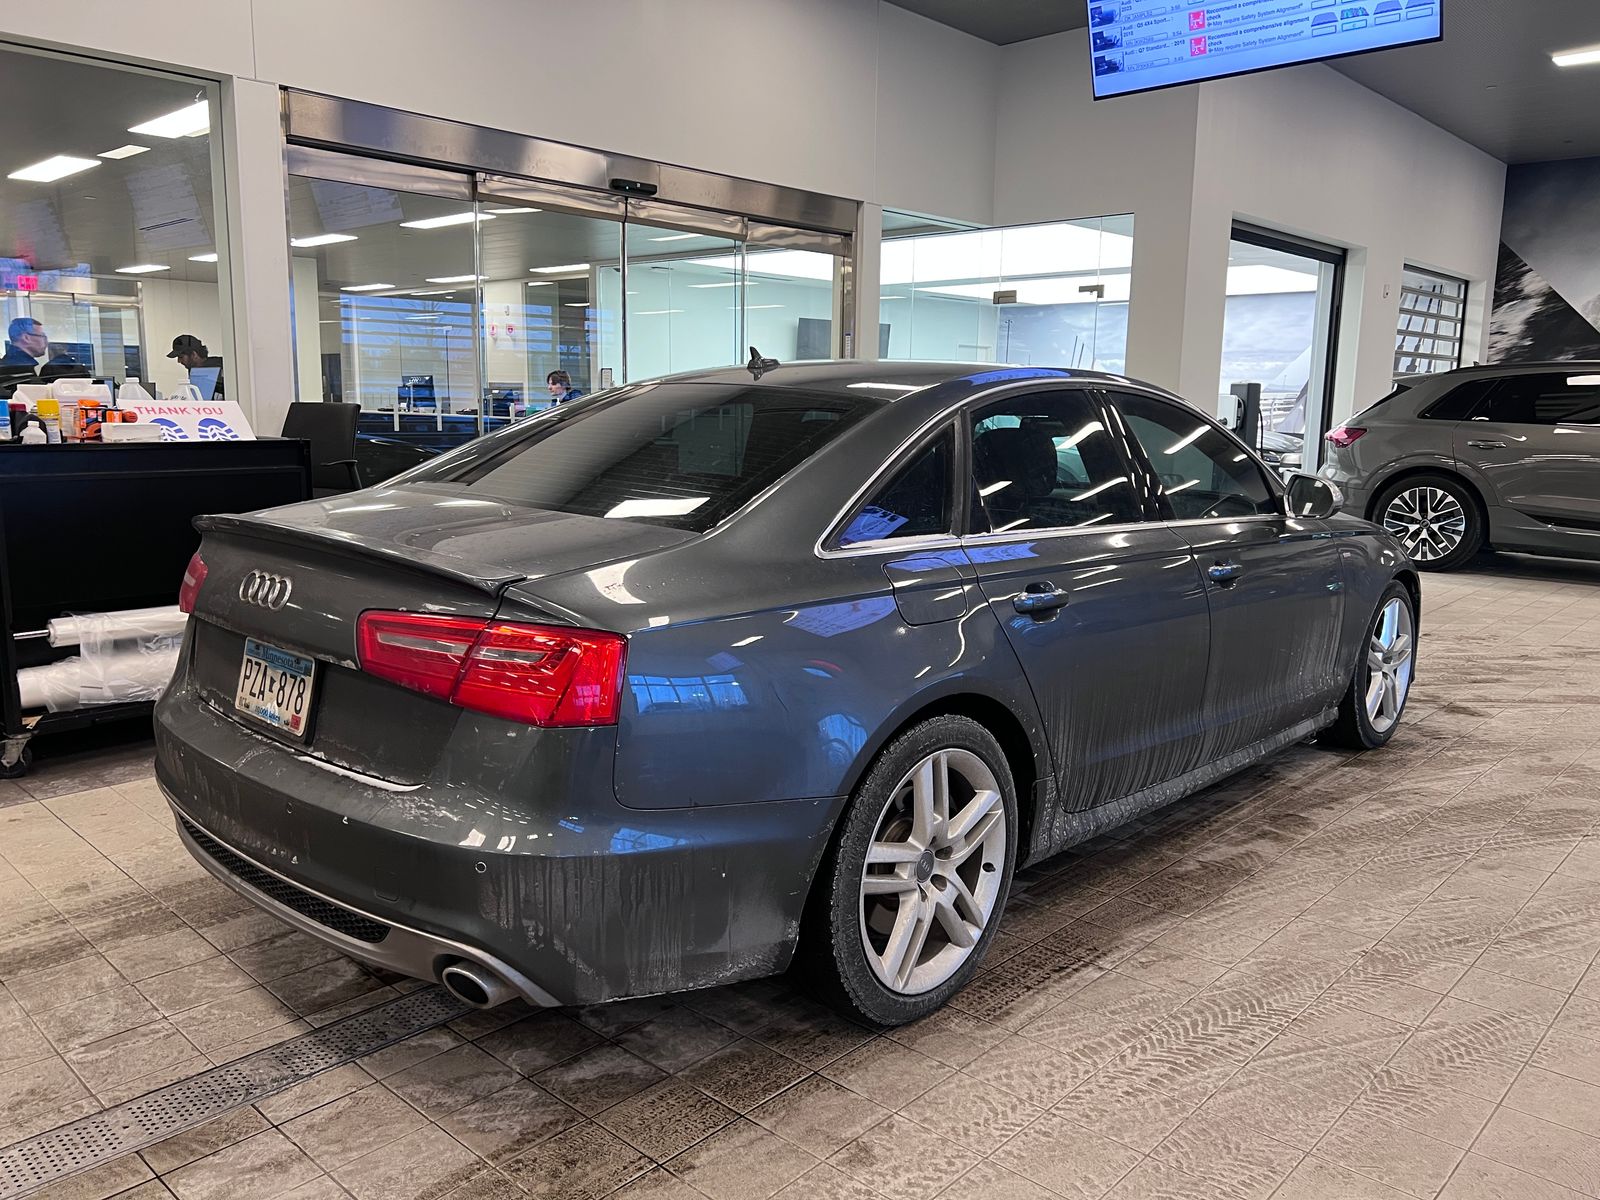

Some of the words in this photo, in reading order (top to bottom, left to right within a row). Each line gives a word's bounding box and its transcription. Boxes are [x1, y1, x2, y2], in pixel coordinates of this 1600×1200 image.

[1206, 4, 1237, 14] Recommend
[1207, 30, 1238, 40] Recommend
[1243, 22, 1282, 34] comprehensive
[1283, 16, 1310, 26] alignment
[1214, 45, 1224, 53] May
[1242, 38, 1257, 46] Safety
[134, 406, 191, 415] THANK
[193, 406, 224, 415] YOU
[262, 647, 295, 668] Minnesota
[241, 658, 268, 701] PZA
[276, 671, 306, 715] 878
